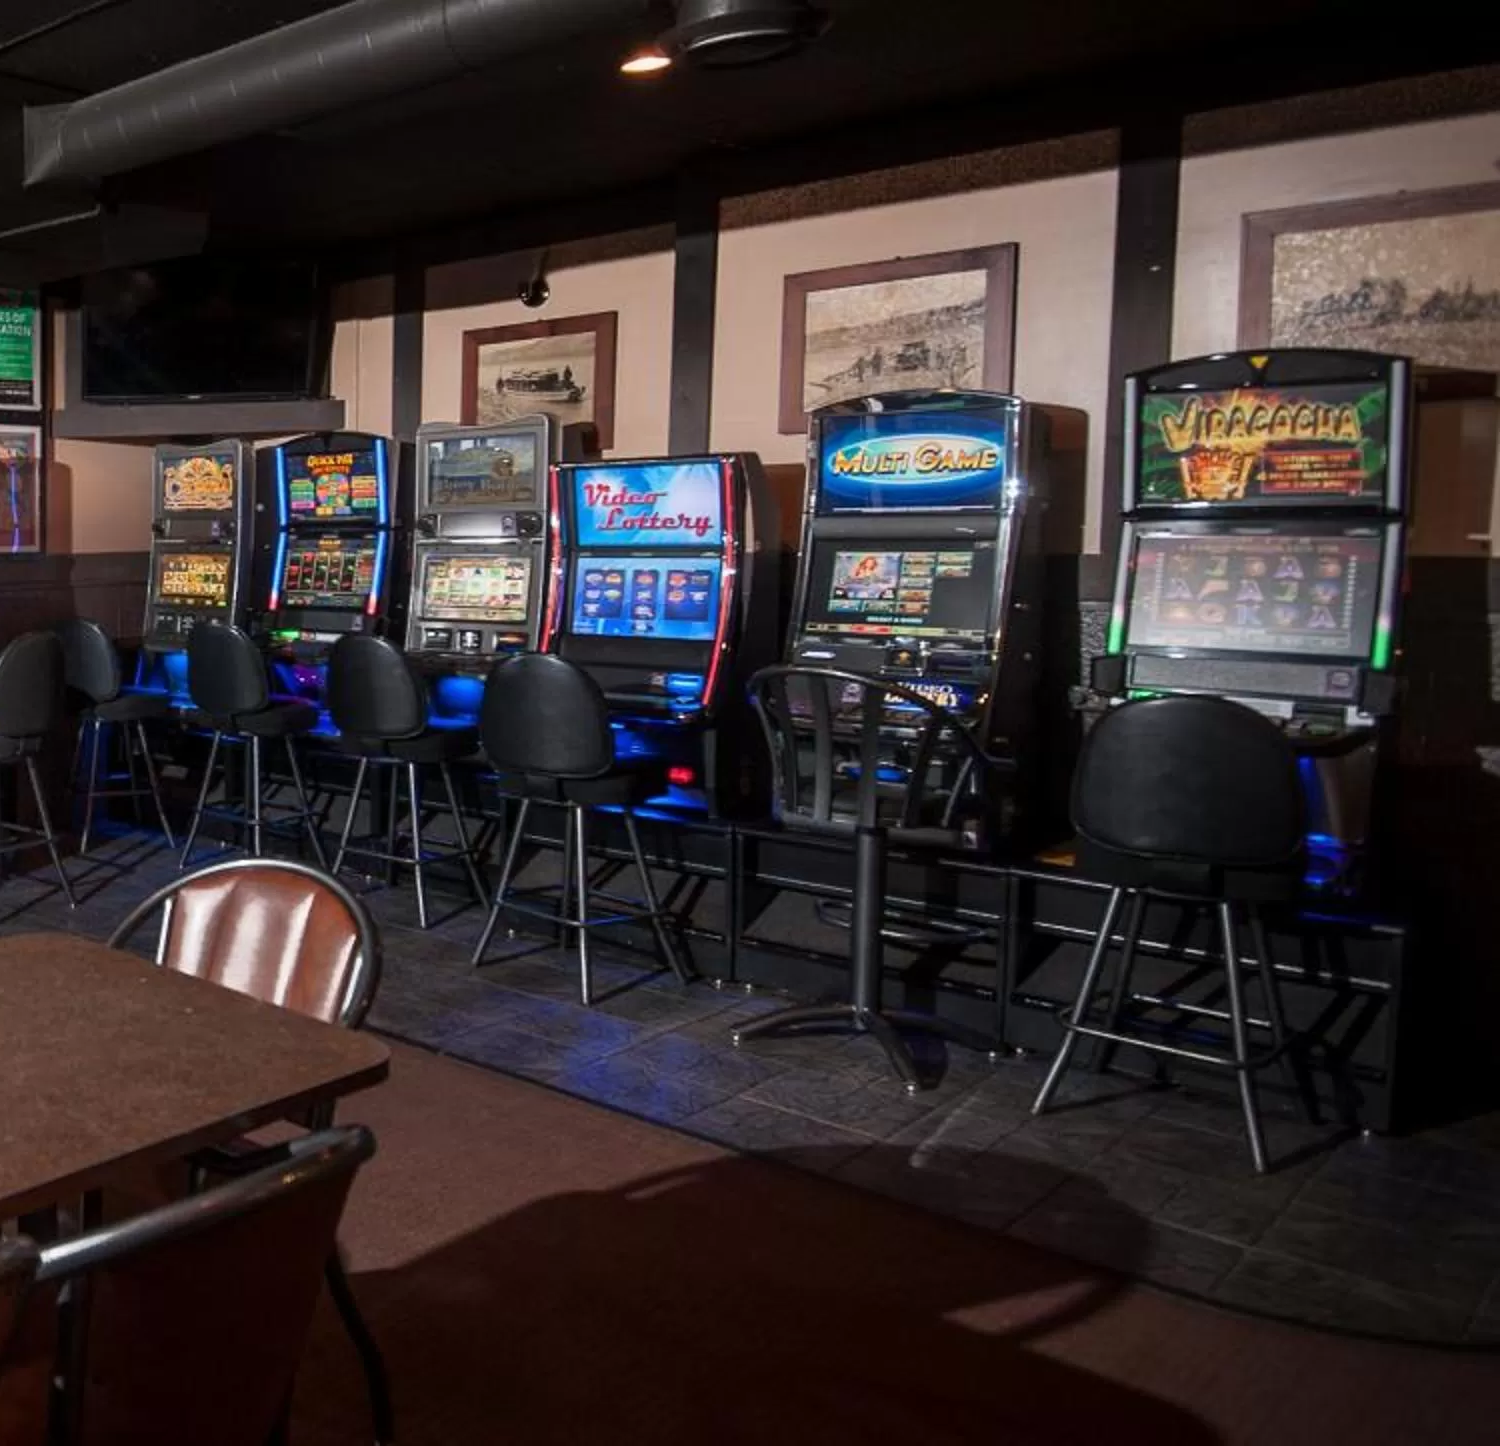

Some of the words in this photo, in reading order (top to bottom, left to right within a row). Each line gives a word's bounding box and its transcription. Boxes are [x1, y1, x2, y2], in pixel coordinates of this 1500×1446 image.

[834, 447, 911, 474] MULTI
[916, 441, 998, 473] GAME
[583, 482, 669, 507] Video
[596, 507, 715, 537] Lottery
